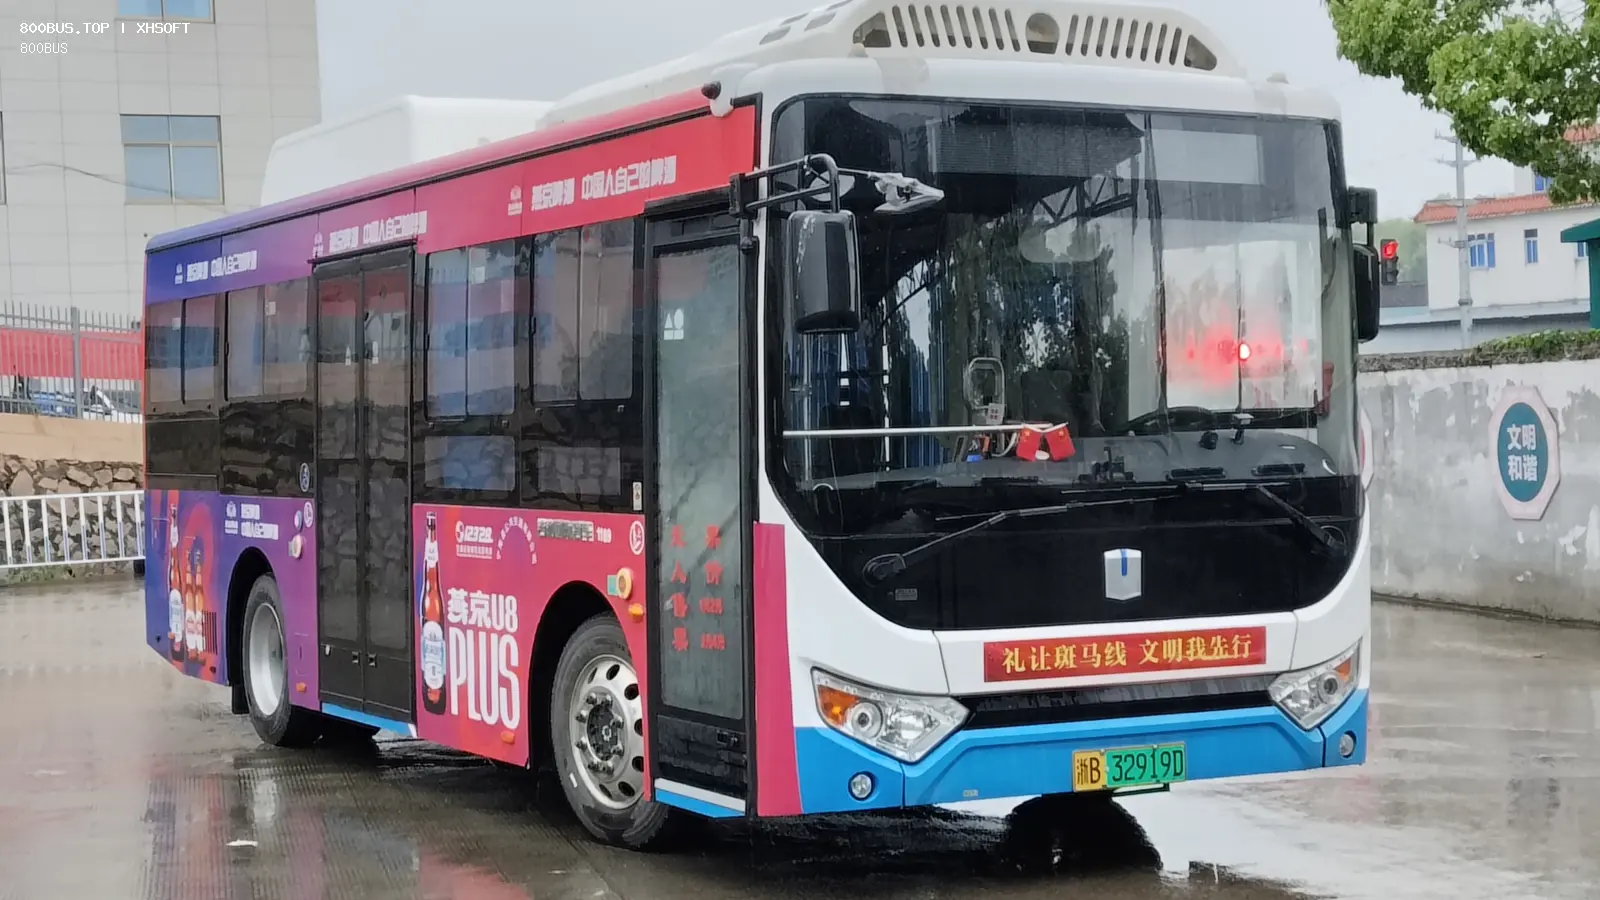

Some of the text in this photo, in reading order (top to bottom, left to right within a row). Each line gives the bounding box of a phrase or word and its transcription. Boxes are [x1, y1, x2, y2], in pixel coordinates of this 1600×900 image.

[1506, 424, 1537, 451] 文明
[1507, 454, 1538, 482] 和谐
[1002, 634, 1252, 674] 礼让斑马线 文明我先行
[449, 626, 520, 730] PLUS
